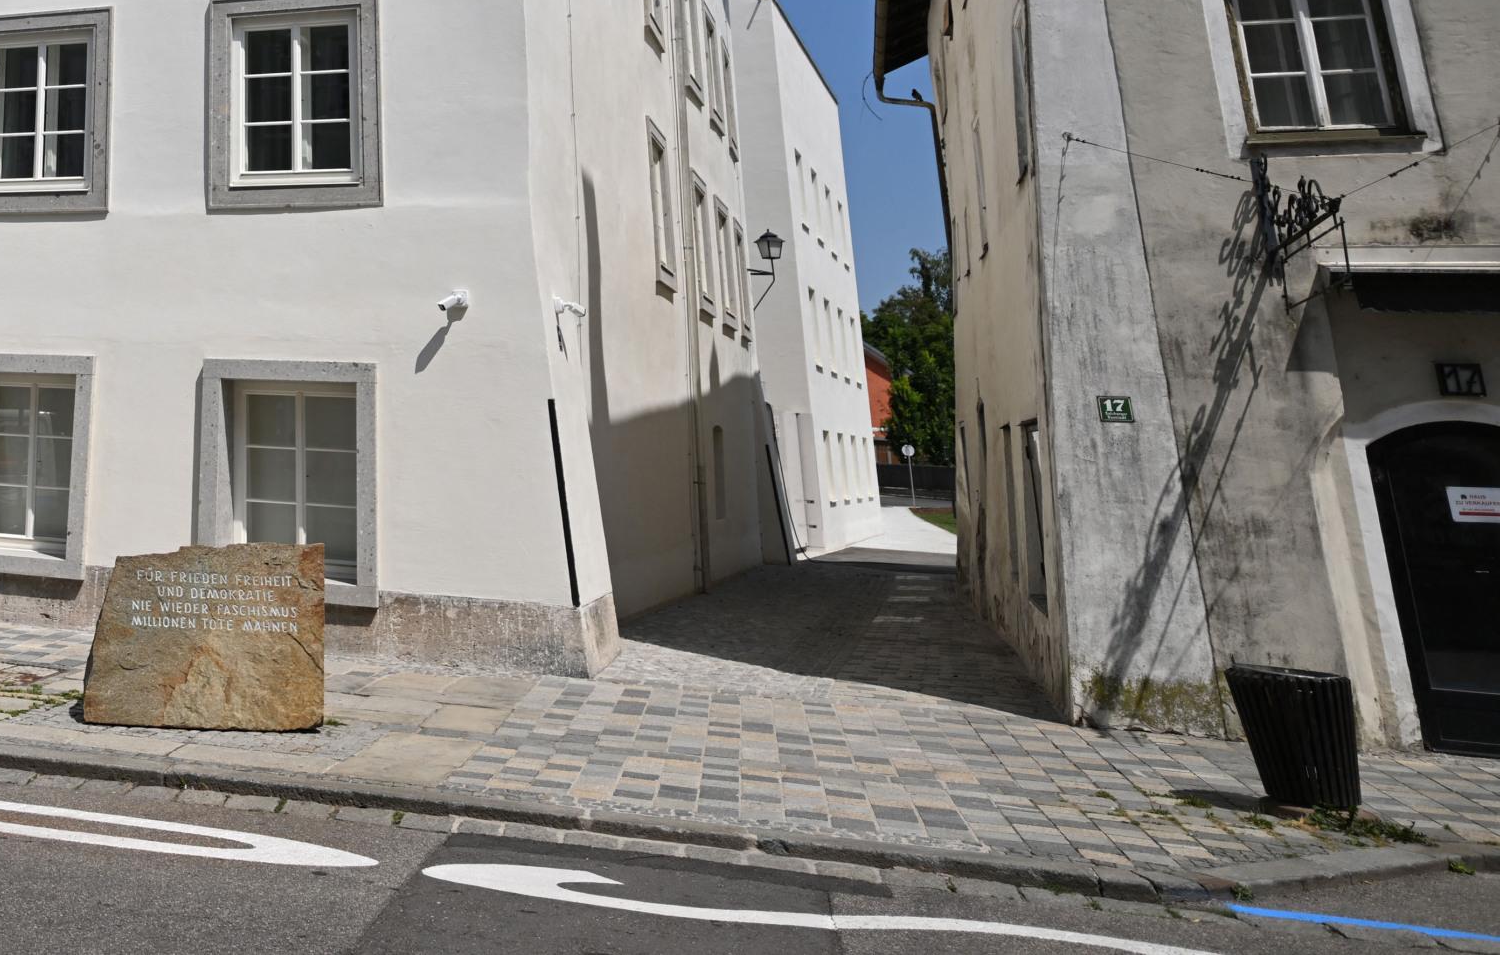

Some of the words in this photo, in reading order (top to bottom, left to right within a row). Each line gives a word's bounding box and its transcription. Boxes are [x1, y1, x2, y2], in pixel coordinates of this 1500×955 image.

[1103, 399, 1125, 412] 17
[137, 567, 163, 582] FÜR
[170, 572, 228, 585] FRIEDEN
[235, 575, 293, 588] FREIHEIT
[157, 586, 183, 598] UND
[190, 588, 276, 602] DEMOKRATIE
[131, 601, 152, 612] NIE
[159, 602, 209, 615] WIEDER
[217, 605, 298, 618] FASCHISMUS
[131, 616, 196, 629] MILLIONEN
[203, 619, 234, 631] TOTE
[243, 621, 298, 633] MAHNEN
